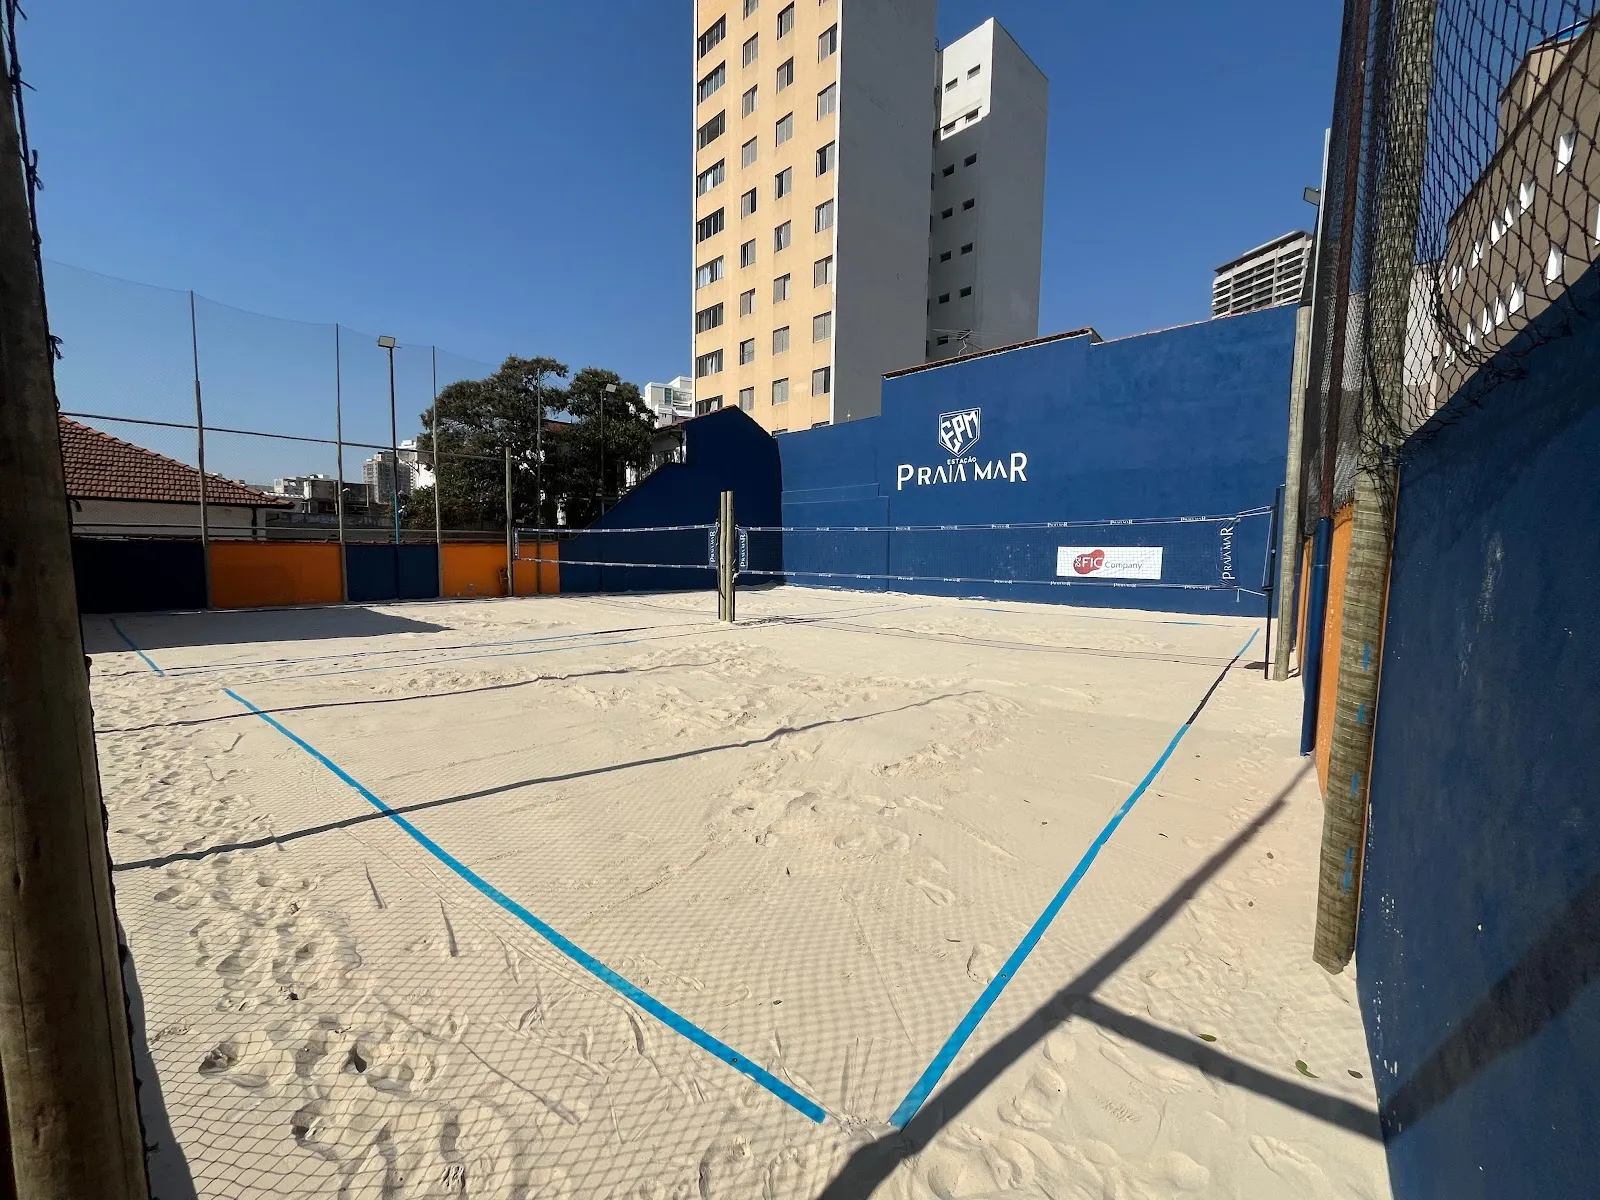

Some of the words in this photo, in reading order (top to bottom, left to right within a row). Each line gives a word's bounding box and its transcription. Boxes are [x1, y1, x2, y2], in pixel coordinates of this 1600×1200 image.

[940, 411, 978, 453] EPM
[946, 456, 977, 465] ESTAÇÃO
[974, 452, 1028, 482] MAR
[1104, 561, 1143, 570] Company
